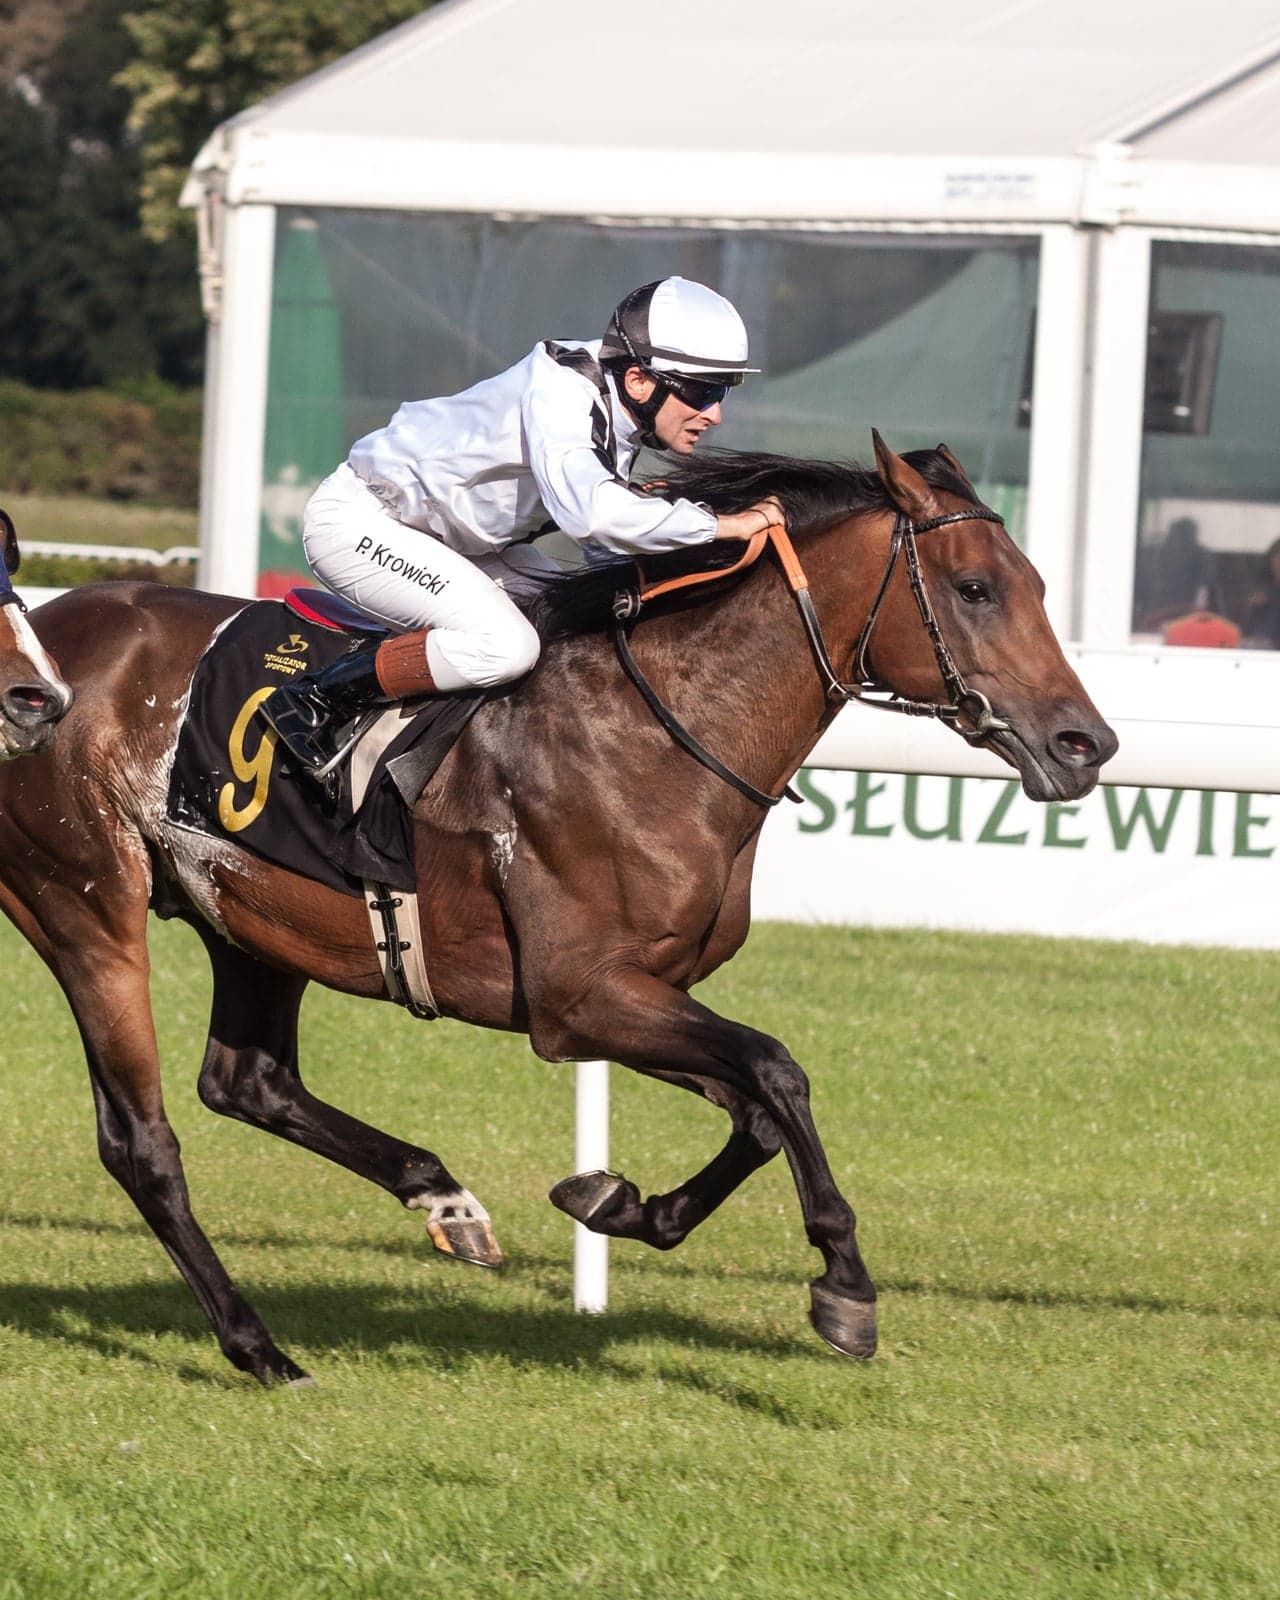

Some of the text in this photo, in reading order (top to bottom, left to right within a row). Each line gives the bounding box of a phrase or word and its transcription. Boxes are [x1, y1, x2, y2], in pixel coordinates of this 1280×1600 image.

[355, 536, 451, 596] P. Krowicki
[263, 653, 308, 671] TOTALIZATOR
[218, 686, 280, 833] 9
